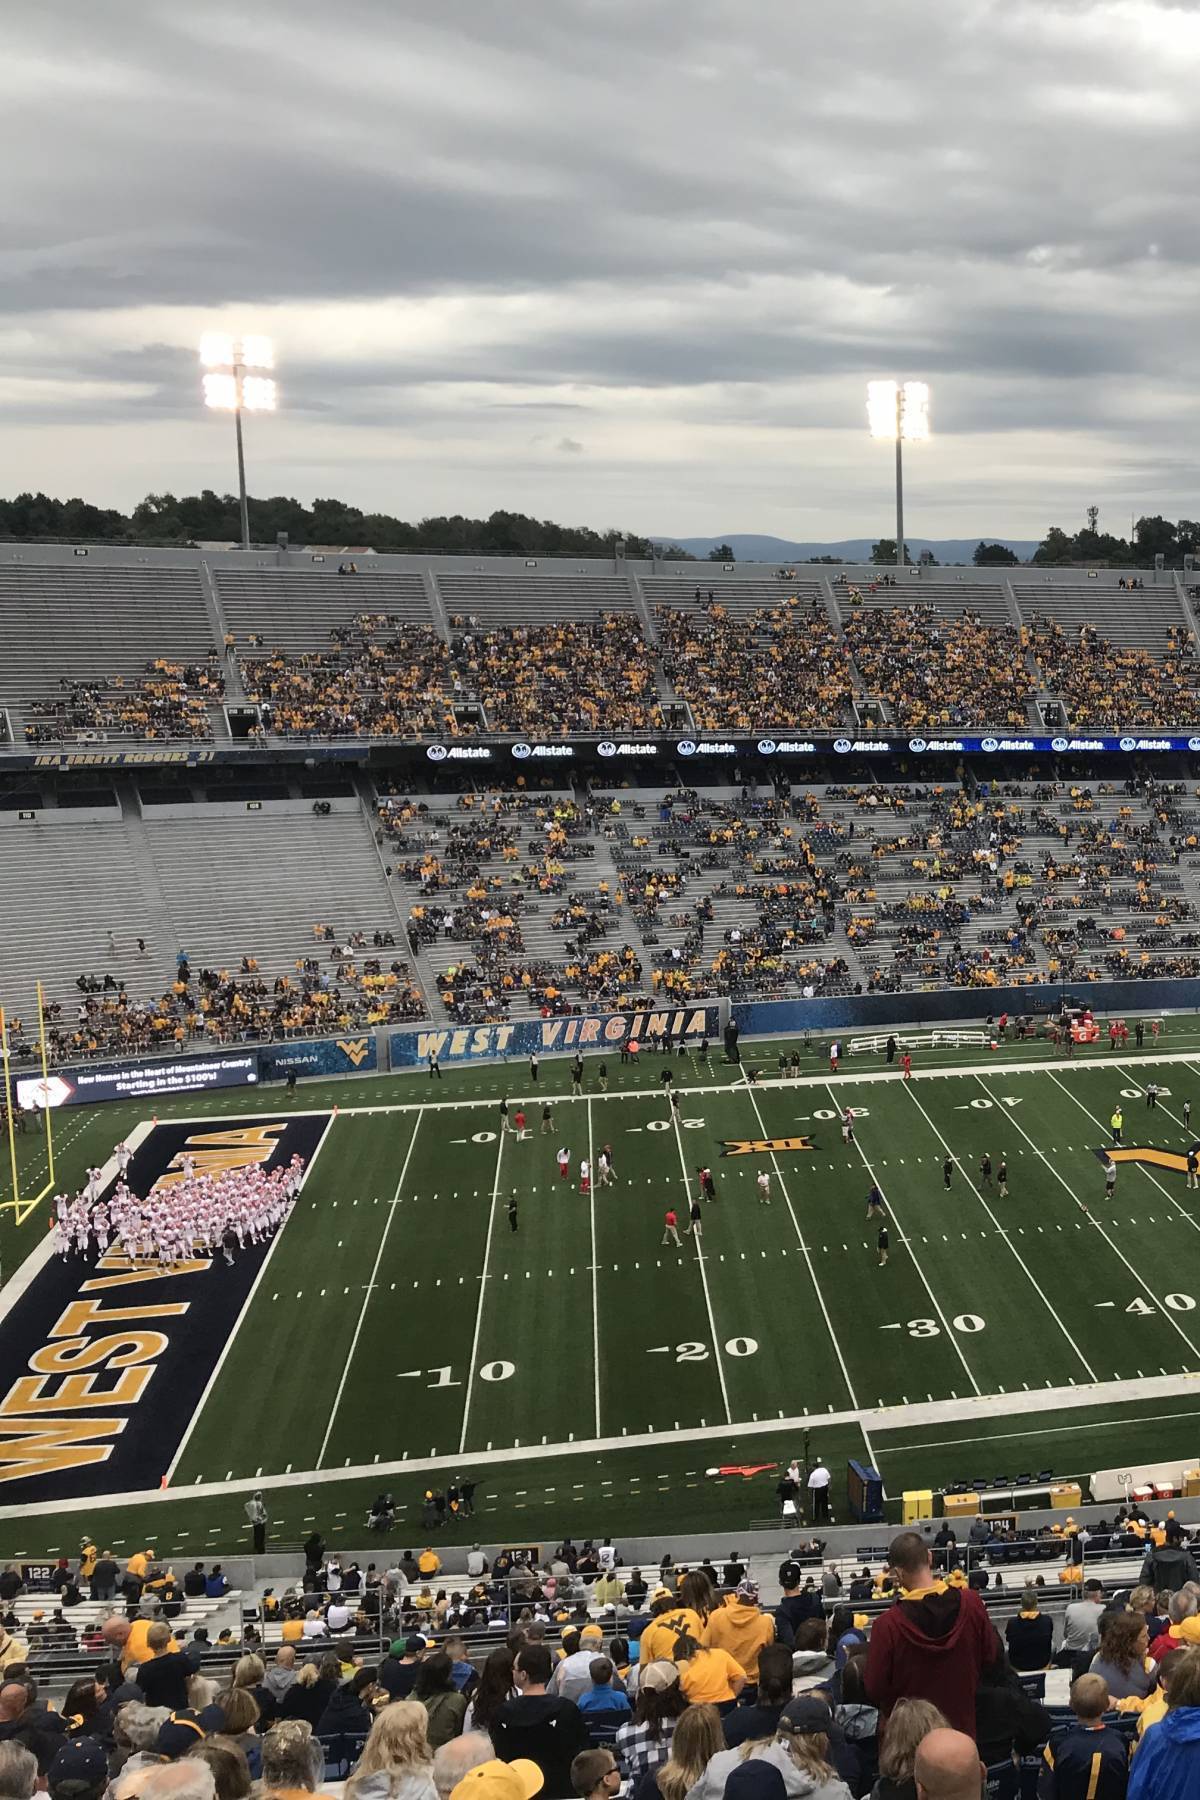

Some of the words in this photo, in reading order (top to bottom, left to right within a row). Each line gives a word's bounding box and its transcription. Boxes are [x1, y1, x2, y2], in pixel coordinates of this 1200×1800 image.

[616, 744, 657, 754] Allstate
[695, 743, 735, 753] Allstate
[775, 742, 815, 752] Allstate
[850, 741, 889, 751] Allstate
[926, 740, 964, 750] Allstate
[998, 740, 1035, 750] Allstate
[1068, 740, 1104, 749] Allstate
[1136, 739, 1171, 749] Allstate
[447, 747, 491, 757] Allstate
[531, 746, 573, 756] Allstate
[35, 755, 61, 766] IRA
[66, 754, 120, 765] ERRETT
[123, 752, 190, 763] RODGERS
[418, 1026, 515, 1057] WEST
[542, 1010, 706, 1046] VIRGINIA
[275, 1055, 318, 1066] NISSAN
[78, 1074, 95, 1085] New
[95, 1071, 121, 1083] Homes
[130, 1069, 144, 1079] the
[145, 1067, 165, 1077] Heart
[175, 1062, 221, 1074] Mountaineer
[221, 1057, 252, 1070] Country!
[116, 1078, 154, 1092] Starting
[156, 1077, 166, 1087] in
[167, 1076, 184, 1086] the
[185, 1072, 217, 1085] $100's!
[1124, 1293, 1197, 1316] 40
[906, 1314, 987, 1338] 30
[675, 1337, 760, 1363] 20
[426, 1361, 516, 1389] 10
[0, 1299, 191, 1483] WEST
[28, 1567, 50, 1579] 122
